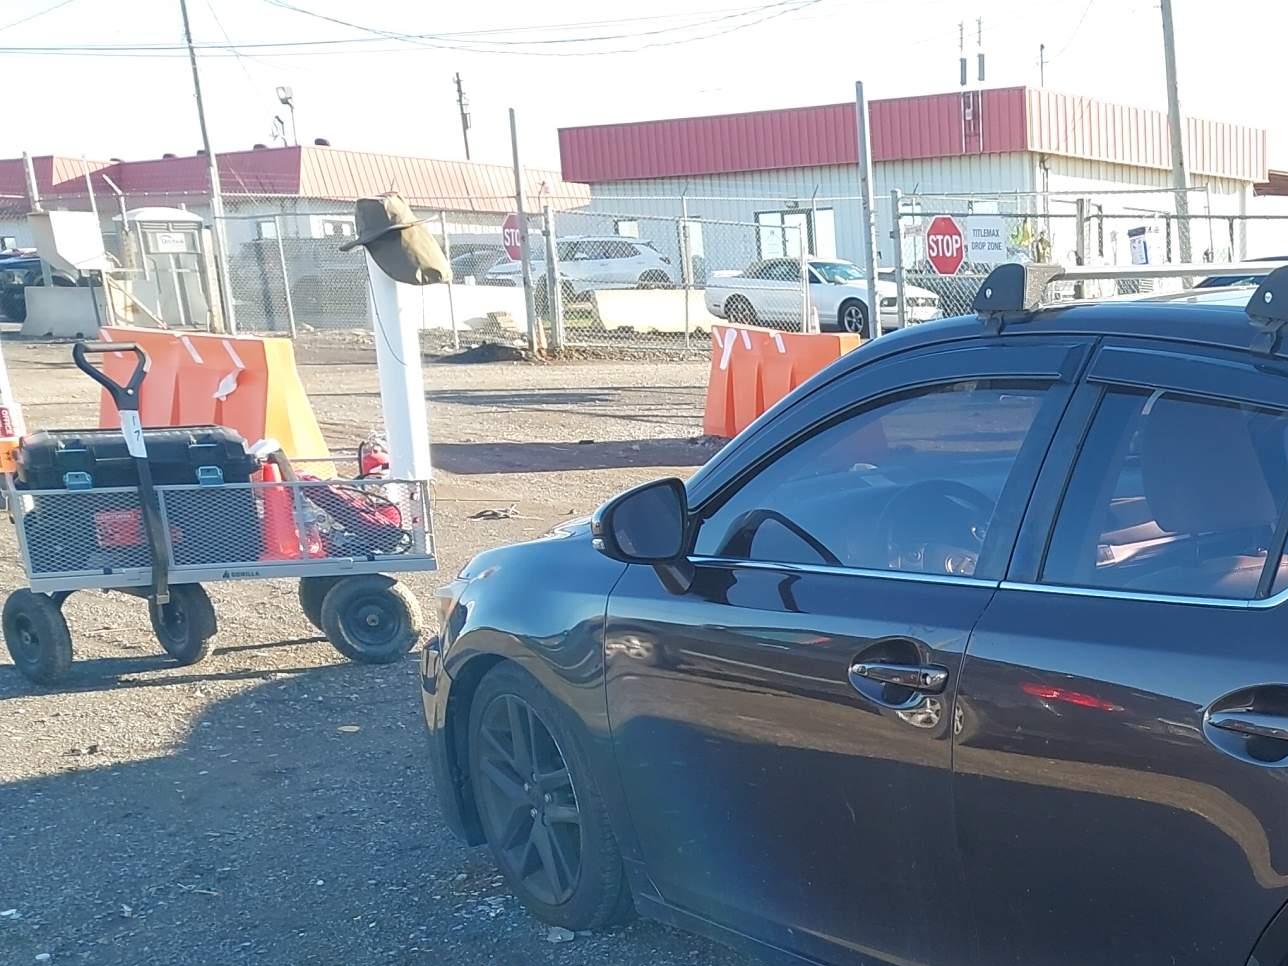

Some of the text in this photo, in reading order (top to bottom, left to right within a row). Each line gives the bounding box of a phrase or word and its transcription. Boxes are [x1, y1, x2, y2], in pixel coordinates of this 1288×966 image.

[504, 228, 521, 247] STO
[972, 228, 1000, 238] TITLEMAX
[929, 234, 961, 257] STOP
[971, 241, 1002, 250] DROP ZONE
